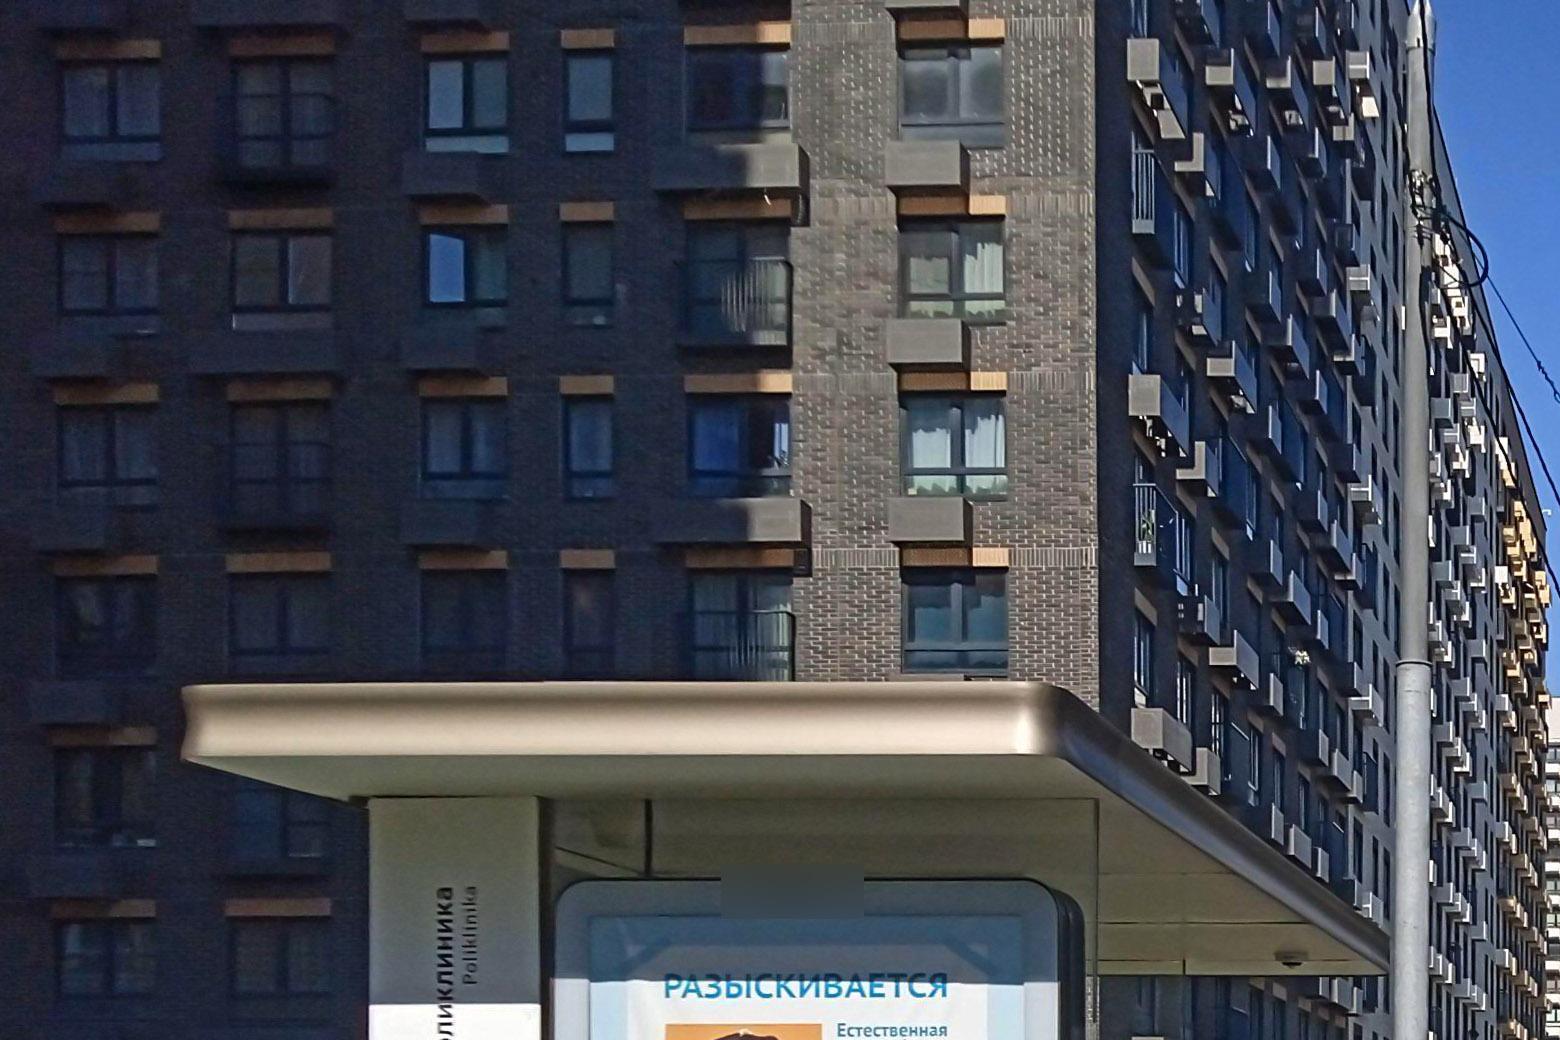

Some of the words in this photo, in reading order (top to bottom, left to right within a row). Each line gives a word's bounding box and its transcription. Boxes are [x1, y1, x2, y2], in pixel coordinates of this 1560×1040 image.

[461, 885, 478, 985] Poliklinika
[664, 972, 948, 999] РАЗЫСКИВАЕТСЯ
[836, 1022, 948, 1038] Естественная
